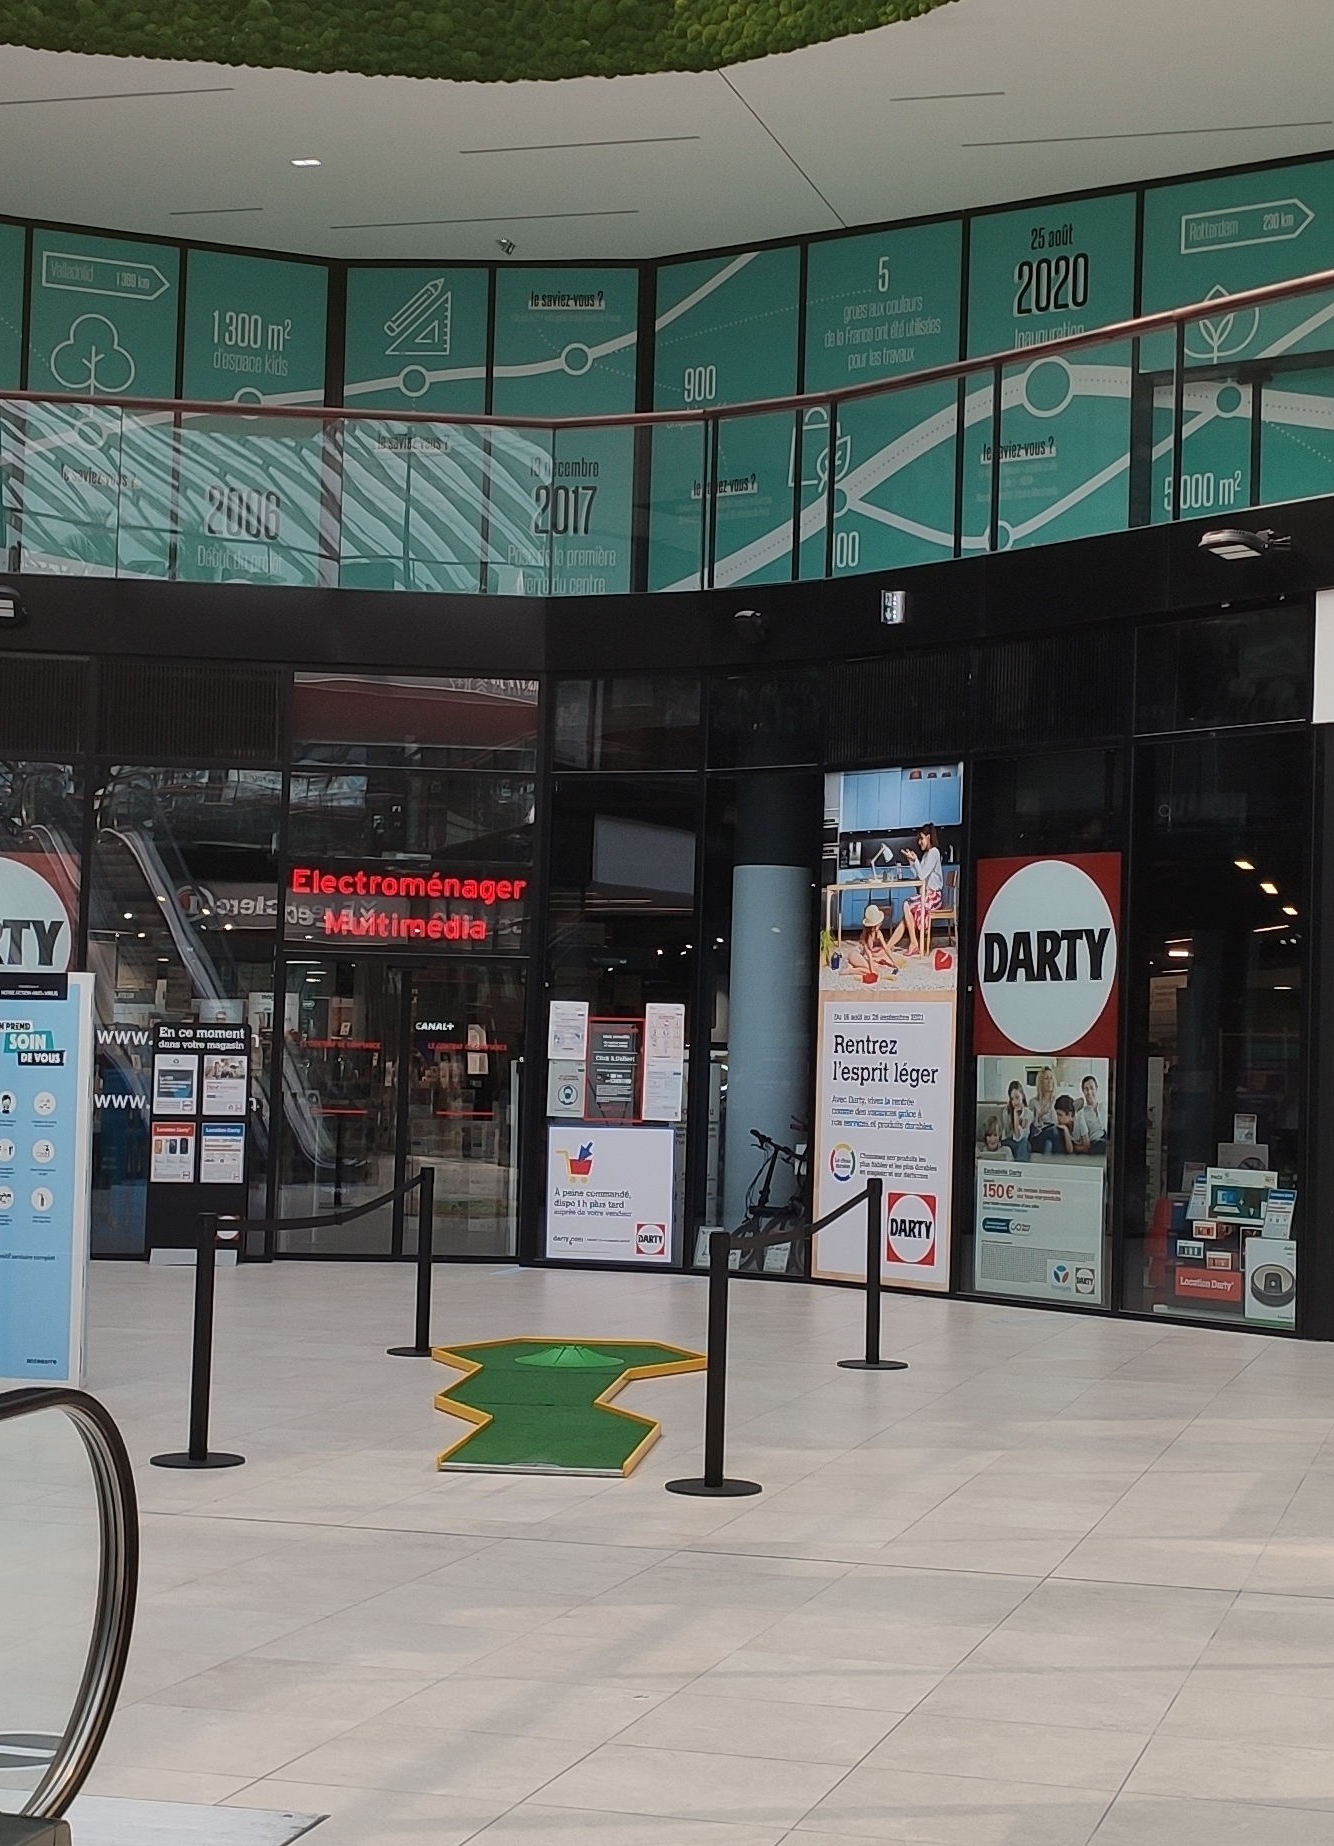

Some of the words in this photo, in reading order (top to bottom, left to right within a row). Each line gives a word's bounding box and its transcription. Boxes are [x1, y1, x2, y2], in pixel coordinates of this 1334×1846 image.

[1030, 228, 1046, 251] 25
[1048, 223, 1074, 249] août
[1189, 218, 1239, 242] Rotterdam
[1263, 212, 1279, 231] 230
[1280, 212, 1294, 229] km
[138, 274, 150, 289] km
[877, 256, 890, 292] 5
[1016, 253, 1089, 316] 2020
[541, 291, 595, 308] saviez-vous
[843, 302, 867, 322] grues
[869, 302, 884, 317] aux
[885, 295, 923, 315] couleurs
[214, 310, 220, 344] 1
[224, 311, 262, 349] 300
[268, 319, 292, 351] m²
[824, 329, 835, 348] de
[836, 329, 844, 347] la
[845, 324, 873, 345] France
[874, 324, 888, 342] ont
[890, 321, 904, 339] été
[905, 317, 941, 339] utilisées
[213, 348, 262, 373] d'espace
[264, 352, 288, 377] kids
[847, 353, 867, 372] pour
[869, 349, 880, 367] les
[882, 345, 916, 366] travaux
[684, 366, 716, 402] 900
[983, 443, 992, 462] le
[530, 457, 542, 478] 13
[544, 457, 599, 478] décembre
[1180, 473, 1215, 509] 000
[1218, 469, 1242, 506] m²
[206, 485, 281, 541] 2006
[533, 486, 597, 535] 2017
[508, 545, 537, 566] Pose
[553, 547, 565, 566] la
[567, 545, 616, 567] première
[557, 574, 568, 594] du
[570, 576, 605, 594] centre
[292, 868, 527, 905] Electroménager
[324, 907, 487, 940] Multimédia
[982, 928, 1111, 983] DARTY
[5, 1022, 31, 1031] PREND
[159, 1027, 176, 1038] En
[178, 1029, 194, 1038] ce
[196, 1027, 245, 1039] moment
[415, 1022, 455, 1031] CANAL+
[8, 1033, 46, 1050] SOIN
[158, 1039, 180, 1049] dans
[182, 1040, 205, 1049] votre
[207, 1041, 245, 1051] magasin
[833, 1034, 898, 1055] Rentrez
[20, 1052, 34, 1063] DE
[35, 1052, 60, 1064] VOUS
[832, 1061, 889, 1086] l'esprit
[893, 1062, 939, 1088] léger
[832, 1095, 848, 1103] Avec
[891, 1097, 915, 1106] rentrée
[554, 1200, 575, 1209] dispo
[608, 1201, 624, 1209] tard
[562, 1190, 584, 1199] peine
[586, 1189, 632, 1200] commandé,
[637, 1234, 663, 1244] DARTY
[889, 1218, 933, 1240] DARTY
[1076, 1276, 1094, 1286] DARTY
[1179, 1276, 1209, 1288] Location
